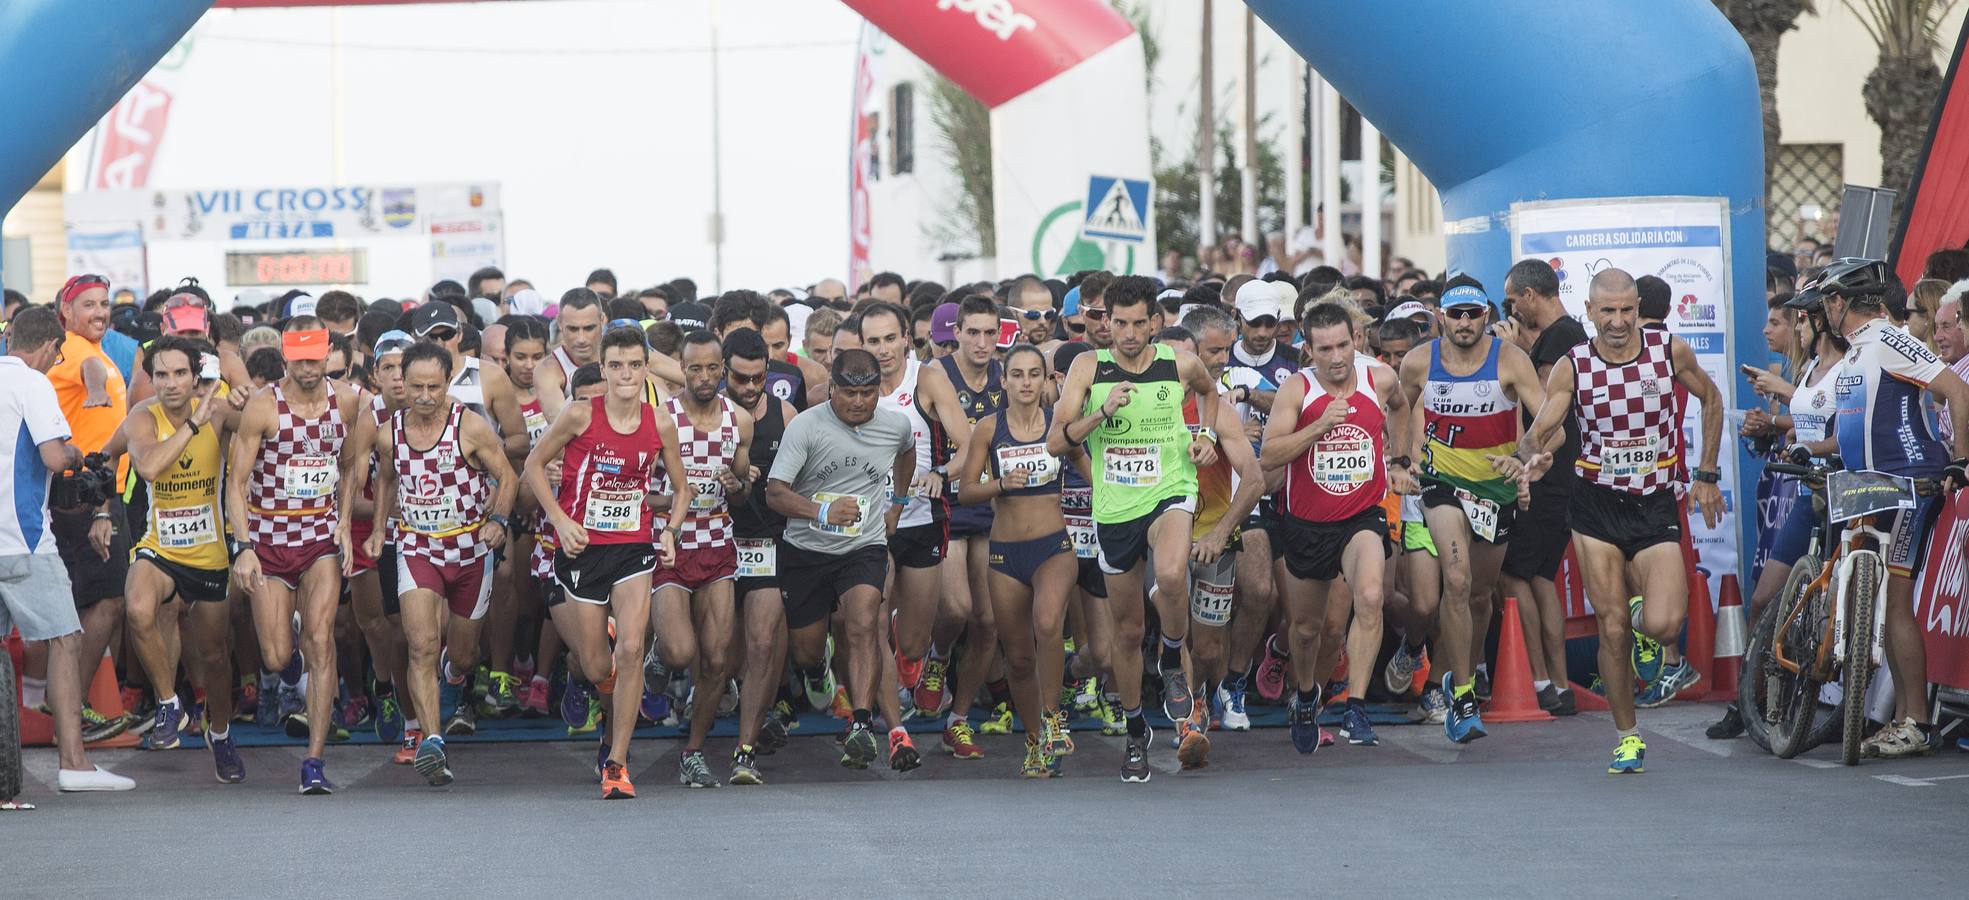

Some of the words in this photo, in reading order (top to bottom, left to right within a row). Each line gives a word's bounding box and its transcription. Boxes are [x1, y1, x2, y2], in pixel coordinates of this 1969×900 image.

[196, 189, 241, 213] VII
[254, 186, 367, 213] CROSS
[1566, 232, 1612, 248] CARRERA
[1613, 230, 1664, 246] SOLIDARIA
[1664, 230, 1683, 244] CON
[1880, 333, 1919, 364] TOTAL
[1323, 426, 1365, 441] CANCHA
[1326, 443, 1359, 451] SPAR
[1611, 438, 1646, 448] SPAR
[1897, 425, 1916, 464] TOTAL
[1008, 446, 1043, 457] SPAR
[1612, 450, 1654, 464] 1188
[297, 459, 327, 467] SPAR
[593, 454, 626, 466] MARATHON
[1113, 459, 1155, 473] 1178
[1326, 455, 1367, 470] 1206
[171, 470, 201, 480] RENAULT
[687, 470, 712, 478] PAR
[817, 461, 838, 481] DIOS
[844, 456, 857, 467] ES
[301, 471, 329, 484] 147
[155, 477, 217, 493] automenor
[688, 482, 716, 495] 32
[1323, 481, 1351, 493] NING
[600, 492, 632, 502] SPAR
[1842, 488, 1857, 497] FIN
[410, 497, 442, 505] SPAR
[412, 508, 451, 521] 1177
[602, 505, 631, 518] 588
[168, 518, 208, 535] 1341
[1899, 532, 1913, 562] TOTAL
